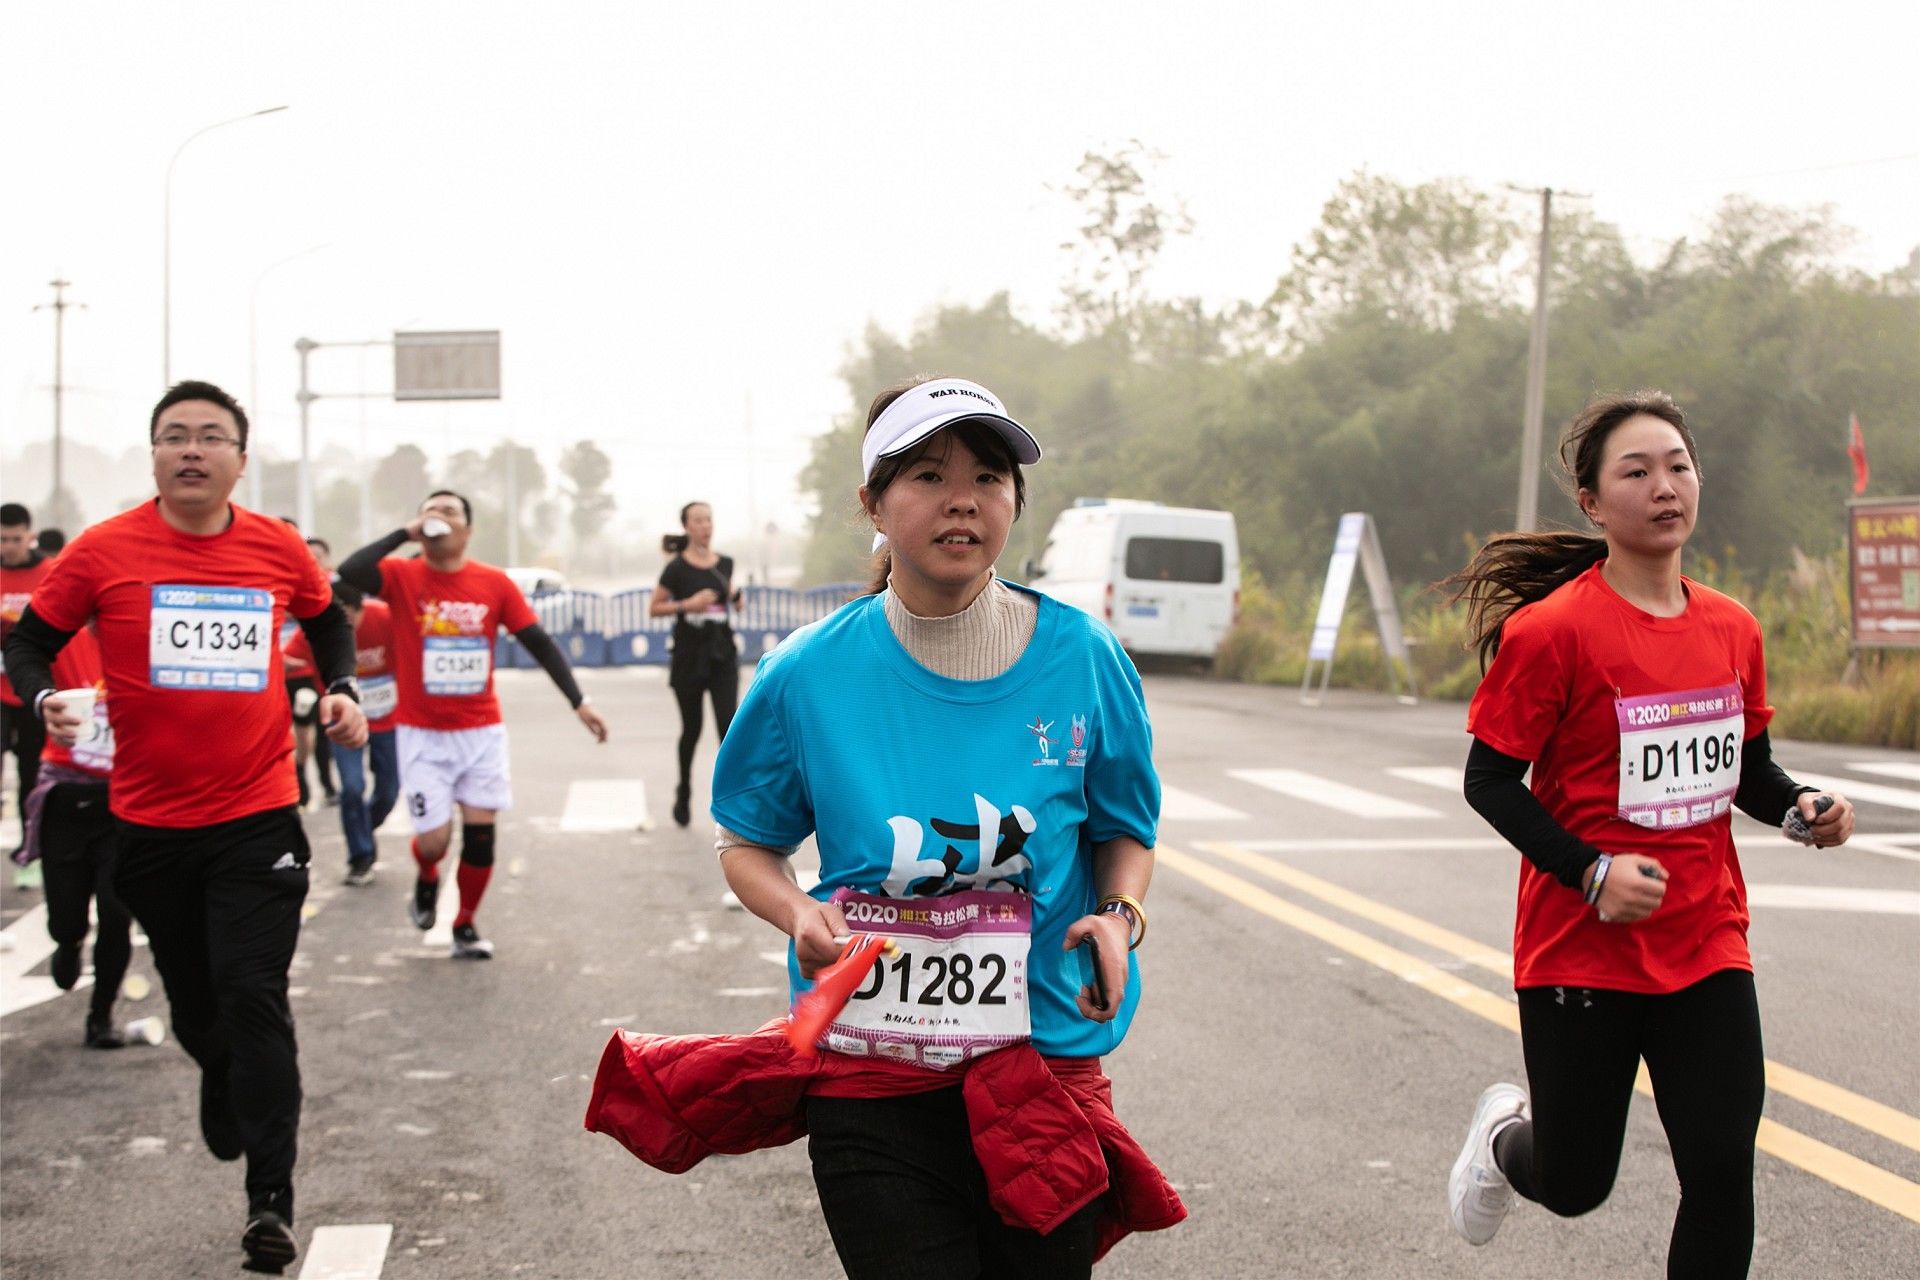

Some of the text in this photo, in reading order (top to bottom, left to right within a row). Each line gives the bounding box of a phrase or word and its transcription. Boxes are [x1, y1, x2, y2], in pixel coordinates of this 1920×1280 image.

[928, 389, 958, 399] WAR
[170, 620, 259, 651] C1334
[1636, 703, 1670, 725] 2020
[1643, 732, 1735, 782] D1196
[845, 901, 898, 924] 2020
[899, 903, 980, 926] 湘江马拉松赛
